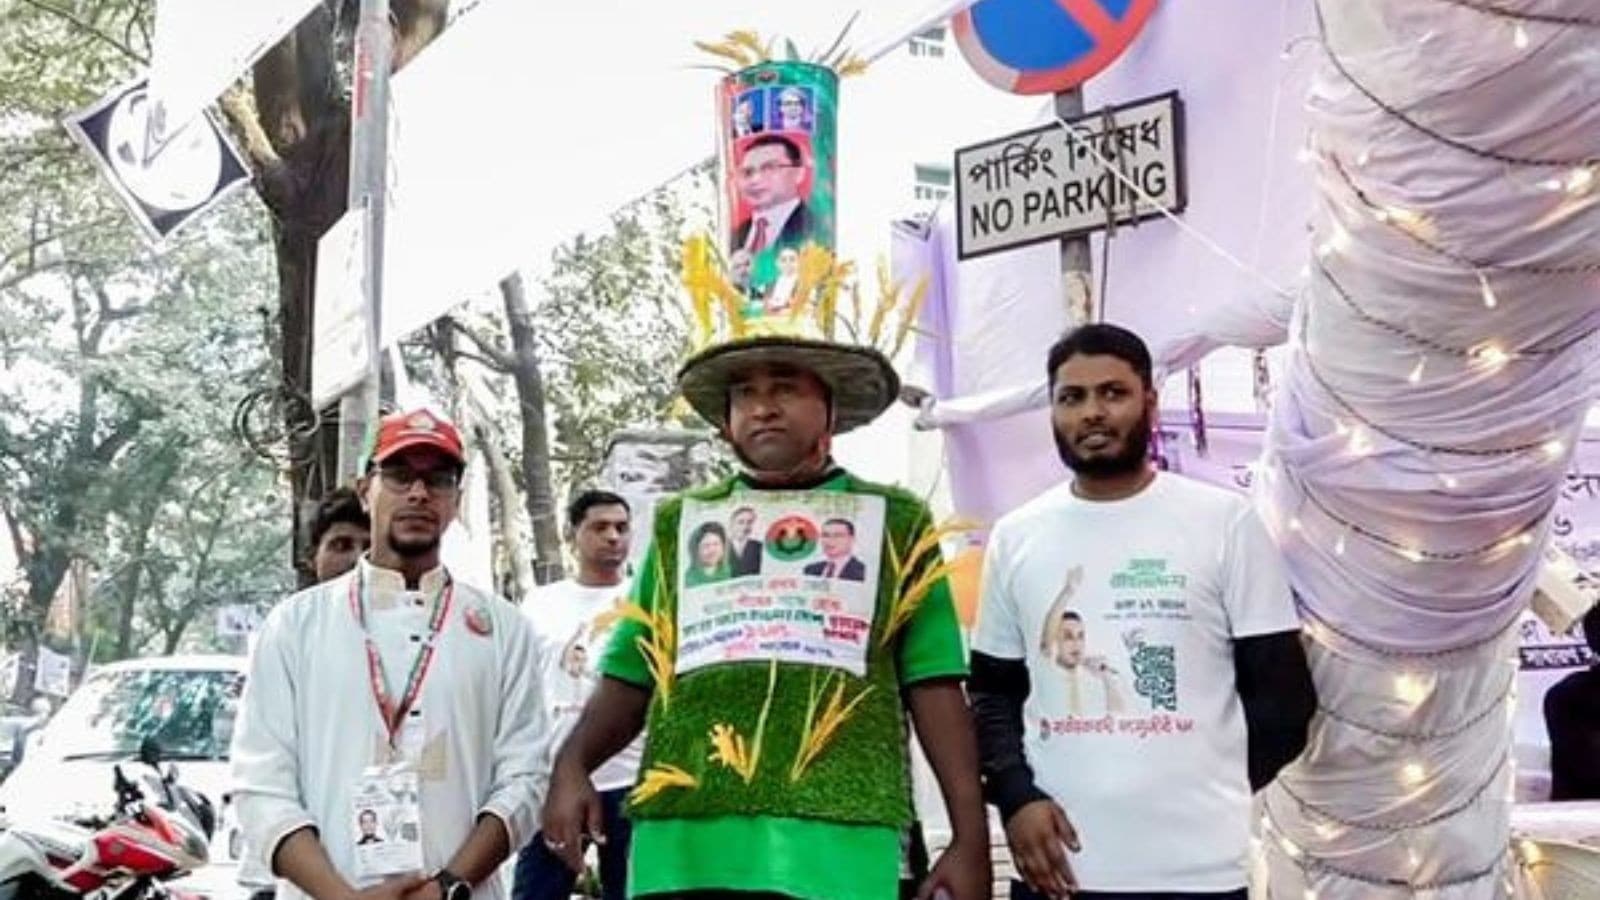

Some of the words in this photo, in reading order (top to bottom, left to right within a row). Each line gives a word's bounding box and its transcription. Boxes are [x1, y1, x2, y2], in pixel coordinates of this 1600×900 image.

[969, 134, 1058, 192] পার্কিং
[970, 198, 1014, 238] NO
[1023, 161, 1167, 225] PARKING
